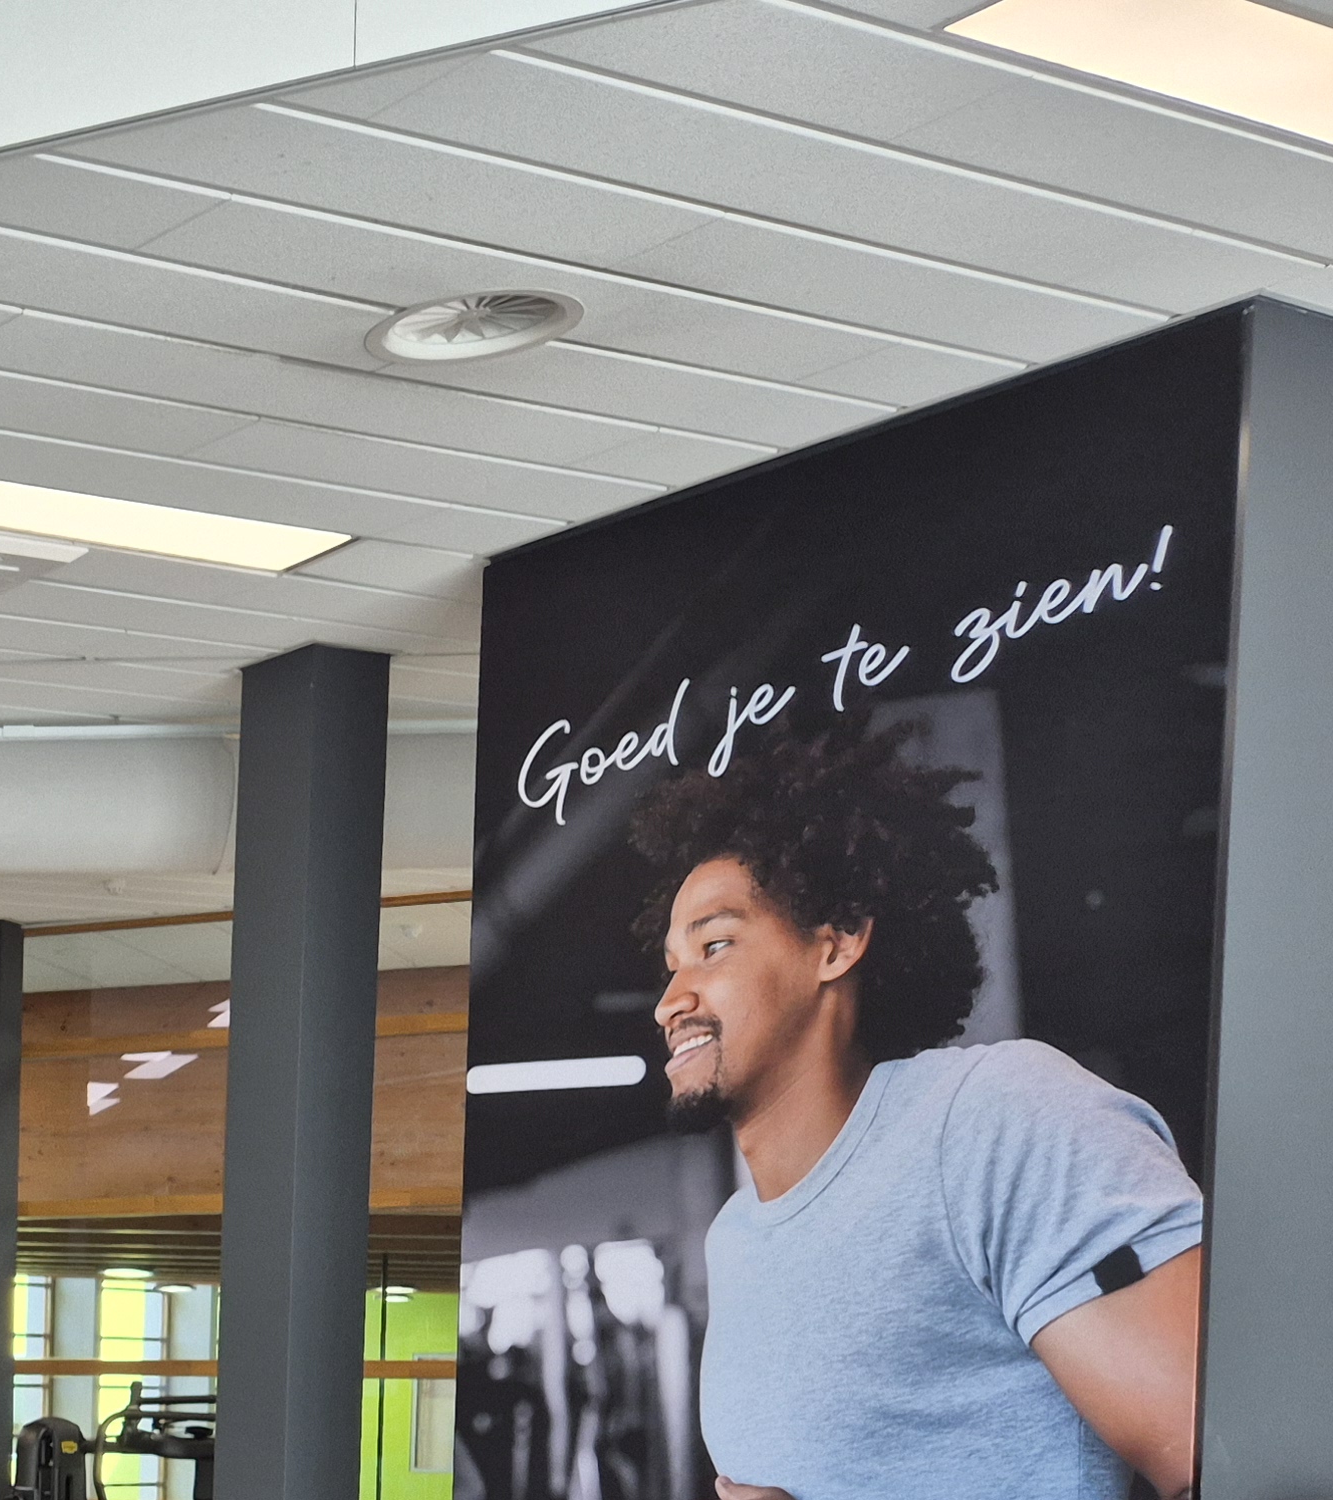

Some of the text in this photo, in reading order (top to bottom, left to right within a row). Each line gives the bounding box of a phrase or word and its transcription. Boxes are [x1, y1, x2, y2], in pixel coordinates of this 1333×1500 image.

[517, 524, 1174, 825] Goed je te zien!
